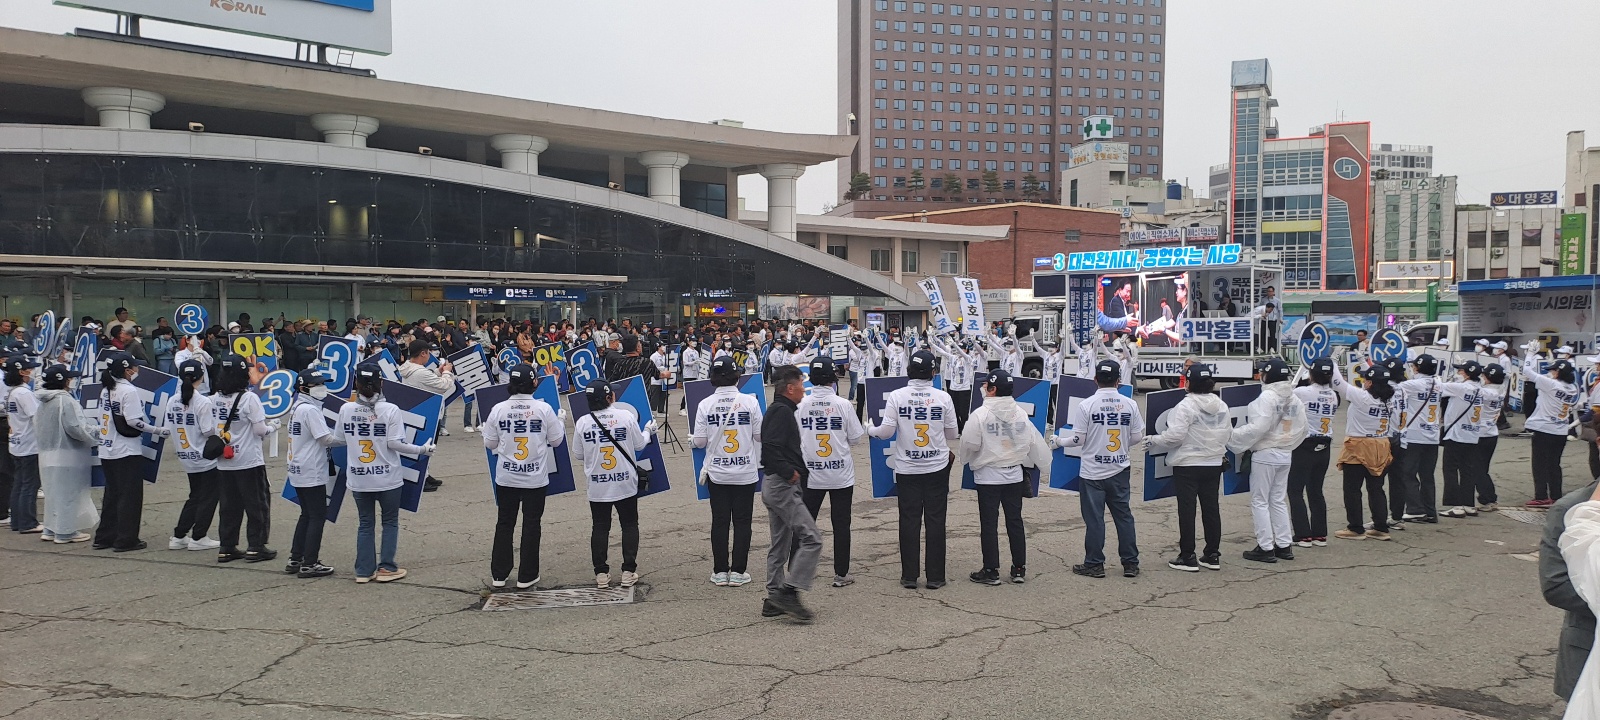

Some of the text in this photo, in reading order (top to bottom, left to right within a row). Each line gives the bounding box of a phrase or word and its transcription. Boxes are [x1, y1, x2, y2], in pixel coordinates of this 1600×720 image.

[1508, 191, 1555, 205] 대명장
[1054, 244, 1241, 271] 3 대전환시대, 경험있는 시장
[1213, 276, 1229, 303] 3
[1504, 280, 1541, 289] 조국혁신당
[962, 280, 980, 331] 영민호조
[1509, 294, 1592, 311] 우리동네 시의원!
[181, 303, 205, 335] 3
[36, 310, 52, 355] 3
[1195, 320, 1251, 339] 박홍률
[233, 336, 274, 358] OK
[535, 345, 564, 366] OK
[240, 361, 246, 369] 3
[322, 341, 352, 393] 3
[499, 351, 522, 372] 3
[570, 348, 600, 389] 3
[732, 362, 737, 371] 3
[1143, 362, 1163, 373] 다시
[1265, 364, 1272, 372] 3
[298, 376, 304, 384] 3
[530, 370, 535, 379] 3
[990, 375, 998, 383] 3
[260, 369, 295, 418] 3
[604, 385, 610, 393] 3
[707, 411, 750, 427] 박홍률
[898, 406, 943, 420] 박홍률
[1091, 412, 1131, 426] 박홍률
[1427, 404, 1438, 422] 3
[1471, 405, 1482, 423] 3
[1558, 403, 1570, 419] 3
[343, 422, 387, 437] 박홍률
[499, 419, 543, 433] 박홍률
[801, 416, 843, 431] 박홍률
[1320, 417, 1331, 434] 3
[1376, 418, 1388, 435] 3
[176, 427, 190, 449] 3
[583, 427, 627, 444] 박홍률
[723, 429, 740, 454] 3
[913, 423, 930, 448] 3
[1106, 429, 1121, 452] 3
[358, 439, 376, 463] 3
[513, 436, 529, 460] 3
[815, 434, 833, 457] 3
[600, 445, 617, 470] 3
[713, 456, 746, 466] 목포시장
[807, 460, 840, 471] 목포시장
[1094, 454, 1127, 464] 목포시장
[350, 465, 384, 476] 목포시장
[503, 461, 535, 473] 목포시장
[591, 473, 624, 483] 목포시장
